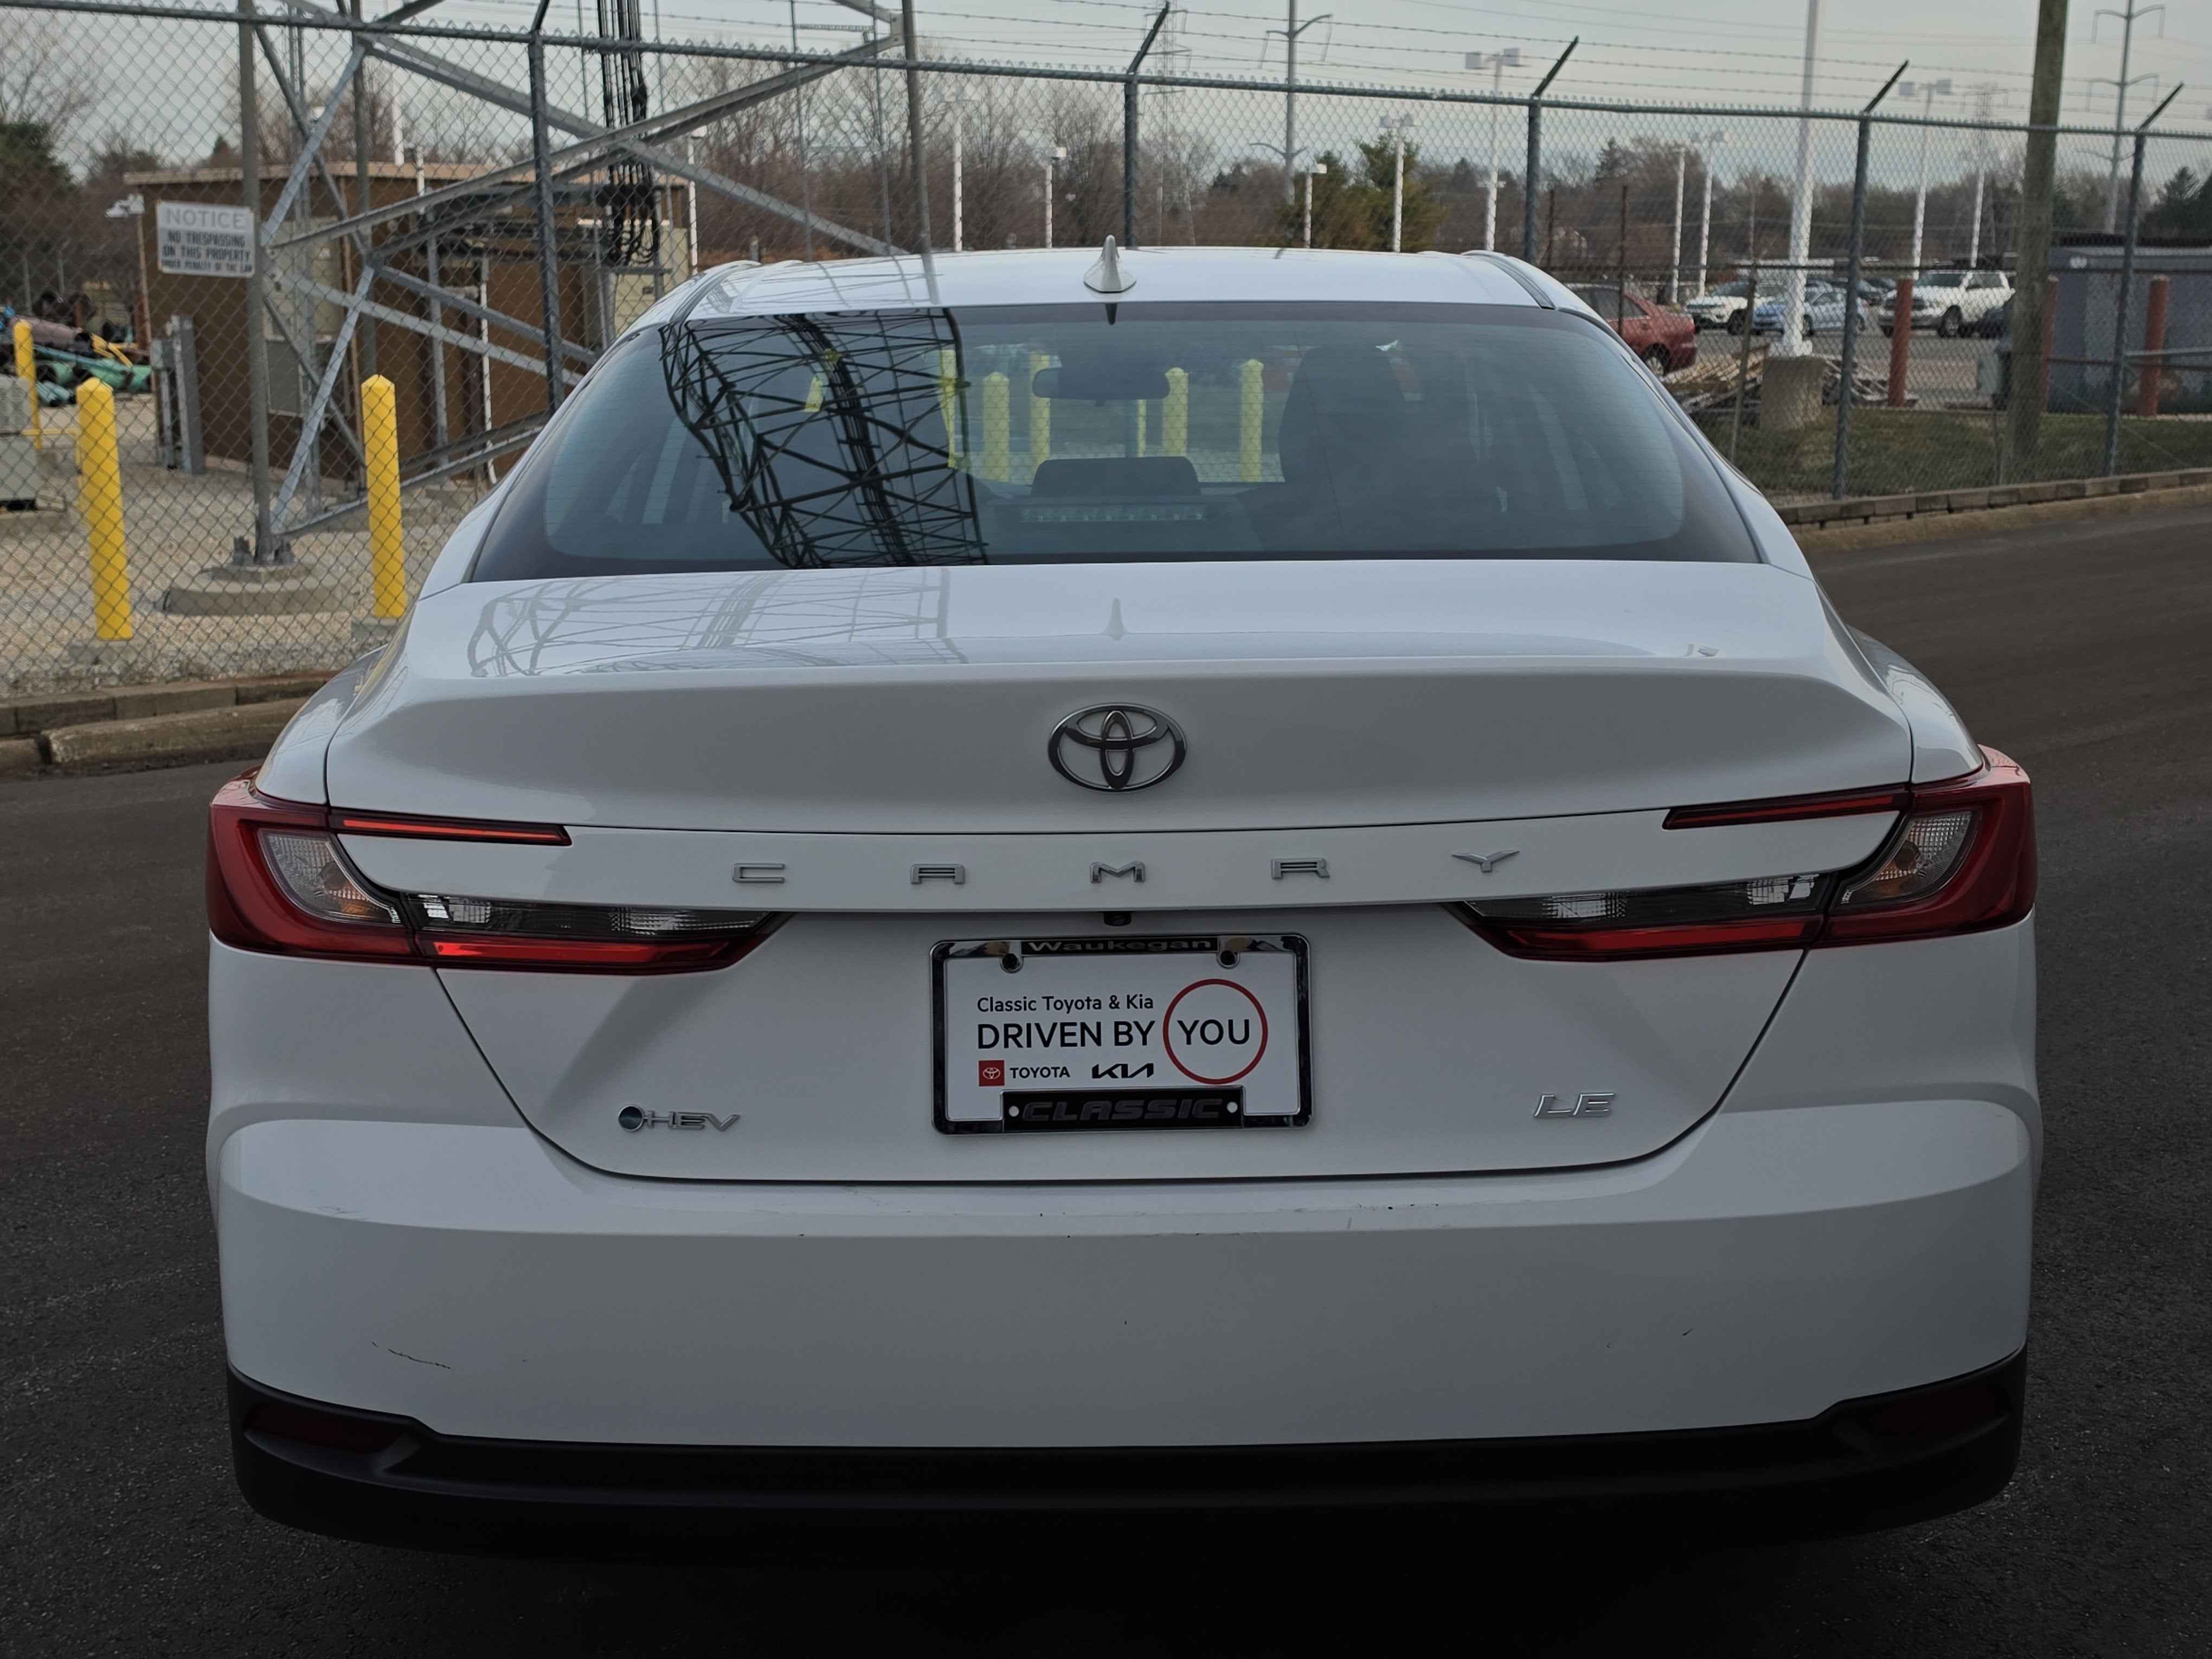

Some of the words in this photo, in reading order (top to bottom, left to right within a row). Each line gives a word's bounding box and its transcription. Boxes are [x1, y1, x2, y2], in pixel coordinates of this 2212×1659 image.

[165, 208, 245, 229] NOTICE
[168, 230, 181, 243] NO
[186, 232, 245, 248] TRESPASSING
[163, 245, 176, 257] ON
[181, 246, 201, 259] THIS
[206, 248, 250, 262] PROPERTY
[731, 850, 1520, 885] CAMRY
[1028, 940, 1211, 952] Waukegan
[978, 996, 1037, 1012] Classic
[1042, 995, 1102, 1014] Toyota
[1108, 995, 1121, 1010] &
[1127, 994, 1154, 1009] Kia
[978, 1021, 1102, 1049] DRIVEN
[1113, 1020, 1155, 1047] BY
[1177, 1019, 1251, 1045] YOU
[1010, 1066, 1070, 1079] TOYOTA
[1022, 1098, 1224, 1122] CLASSIC
[1533, 1092, 1616, 1118] LE
